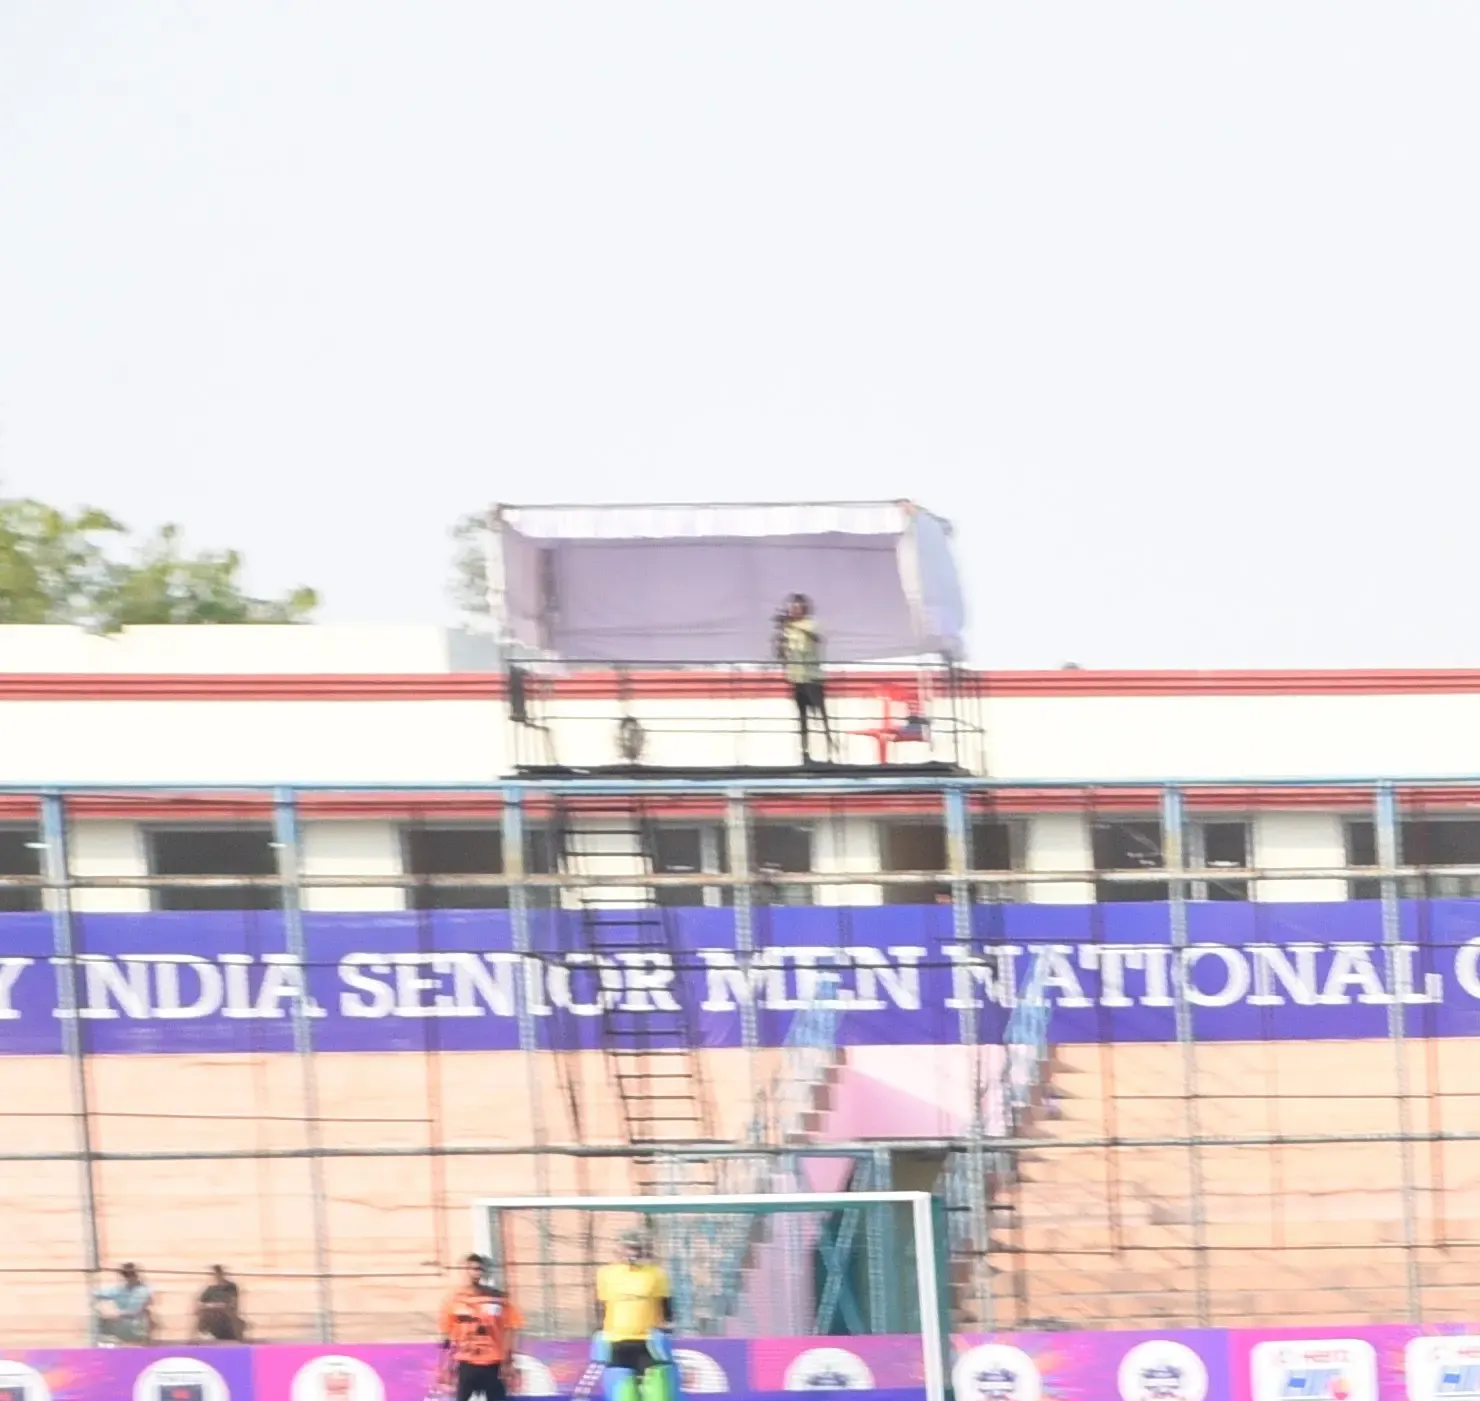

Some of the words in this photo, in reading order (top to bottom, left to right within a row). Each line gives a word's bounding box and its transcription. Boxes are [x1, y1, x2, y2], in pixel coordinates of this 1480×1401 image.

[48, 953, 328, 1019] INDIA
[337, 951, 683, 1018] SENIOR
[697, 945, 927, 1012] MEN
[941, 941, 1444, 1010] NATIONAL
